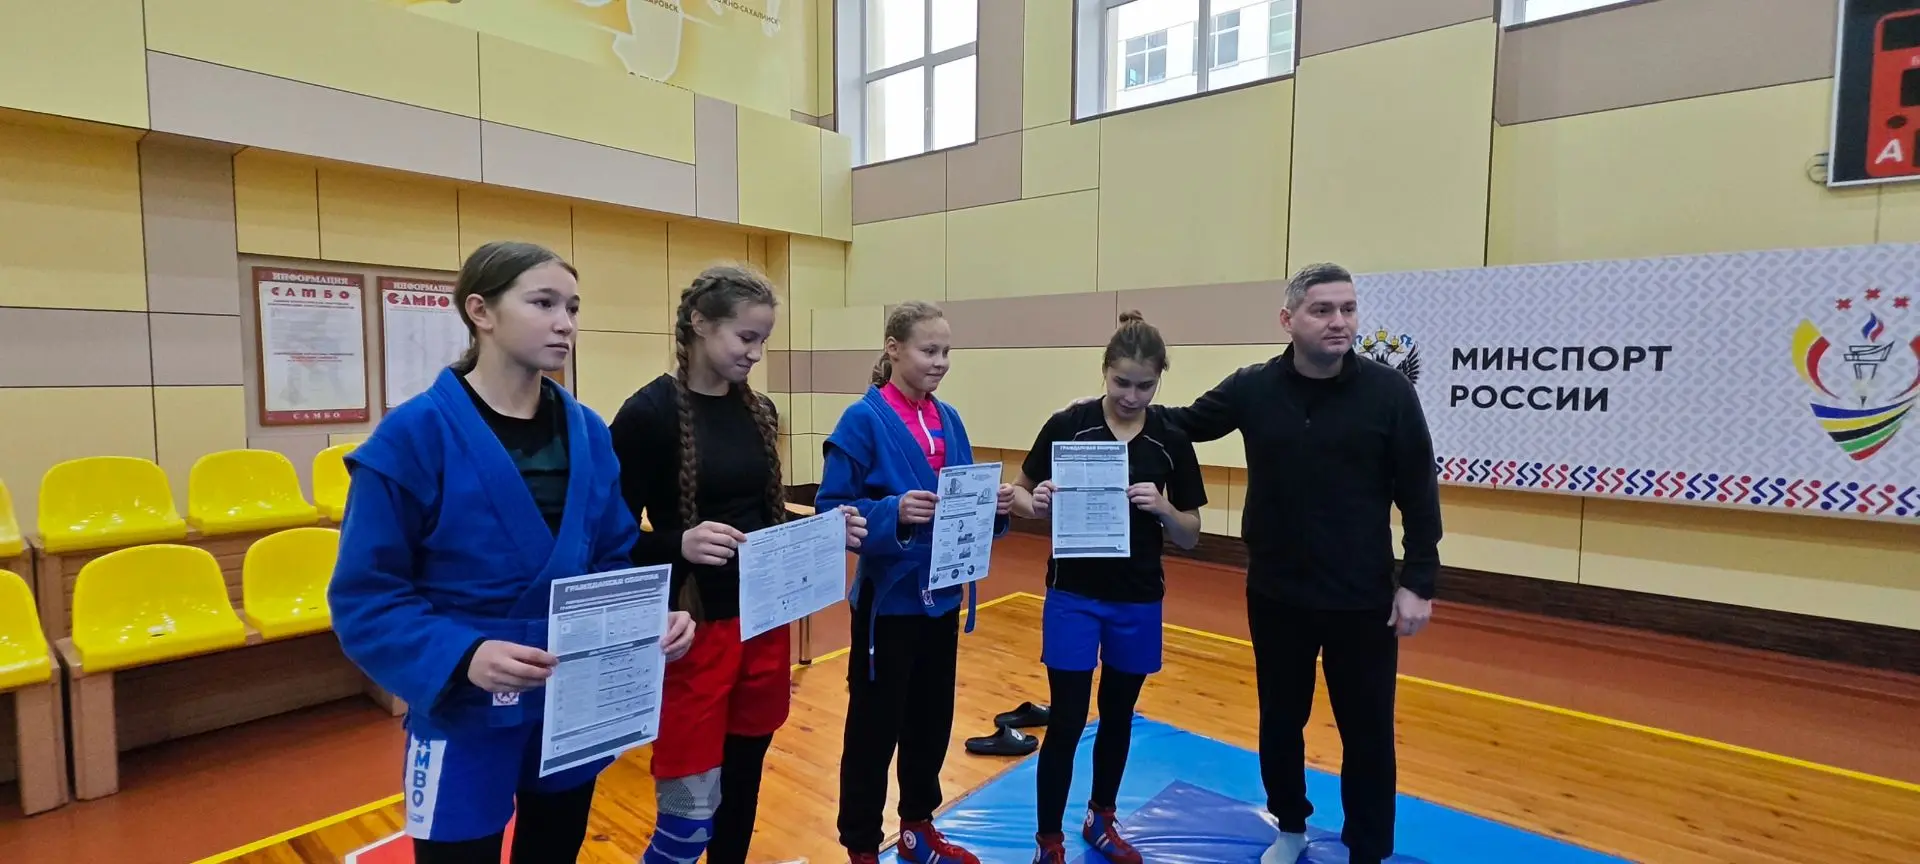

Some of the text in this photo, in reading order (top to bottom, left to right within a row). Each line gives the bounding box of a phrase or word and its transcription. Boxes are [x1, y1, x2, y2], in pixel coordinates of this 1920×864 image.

[272, 272, 349, 285] ИНФОРМАЦИЯ
[271, 286, 350, 299] САМБО
[387, 292, 450, 308] САМБО
[1451, 345, 1673, 372] МИНСПОРТ
[1450, 385, 1609, 412] РОССИИ
[293, 412, 341, 420] САМБО
